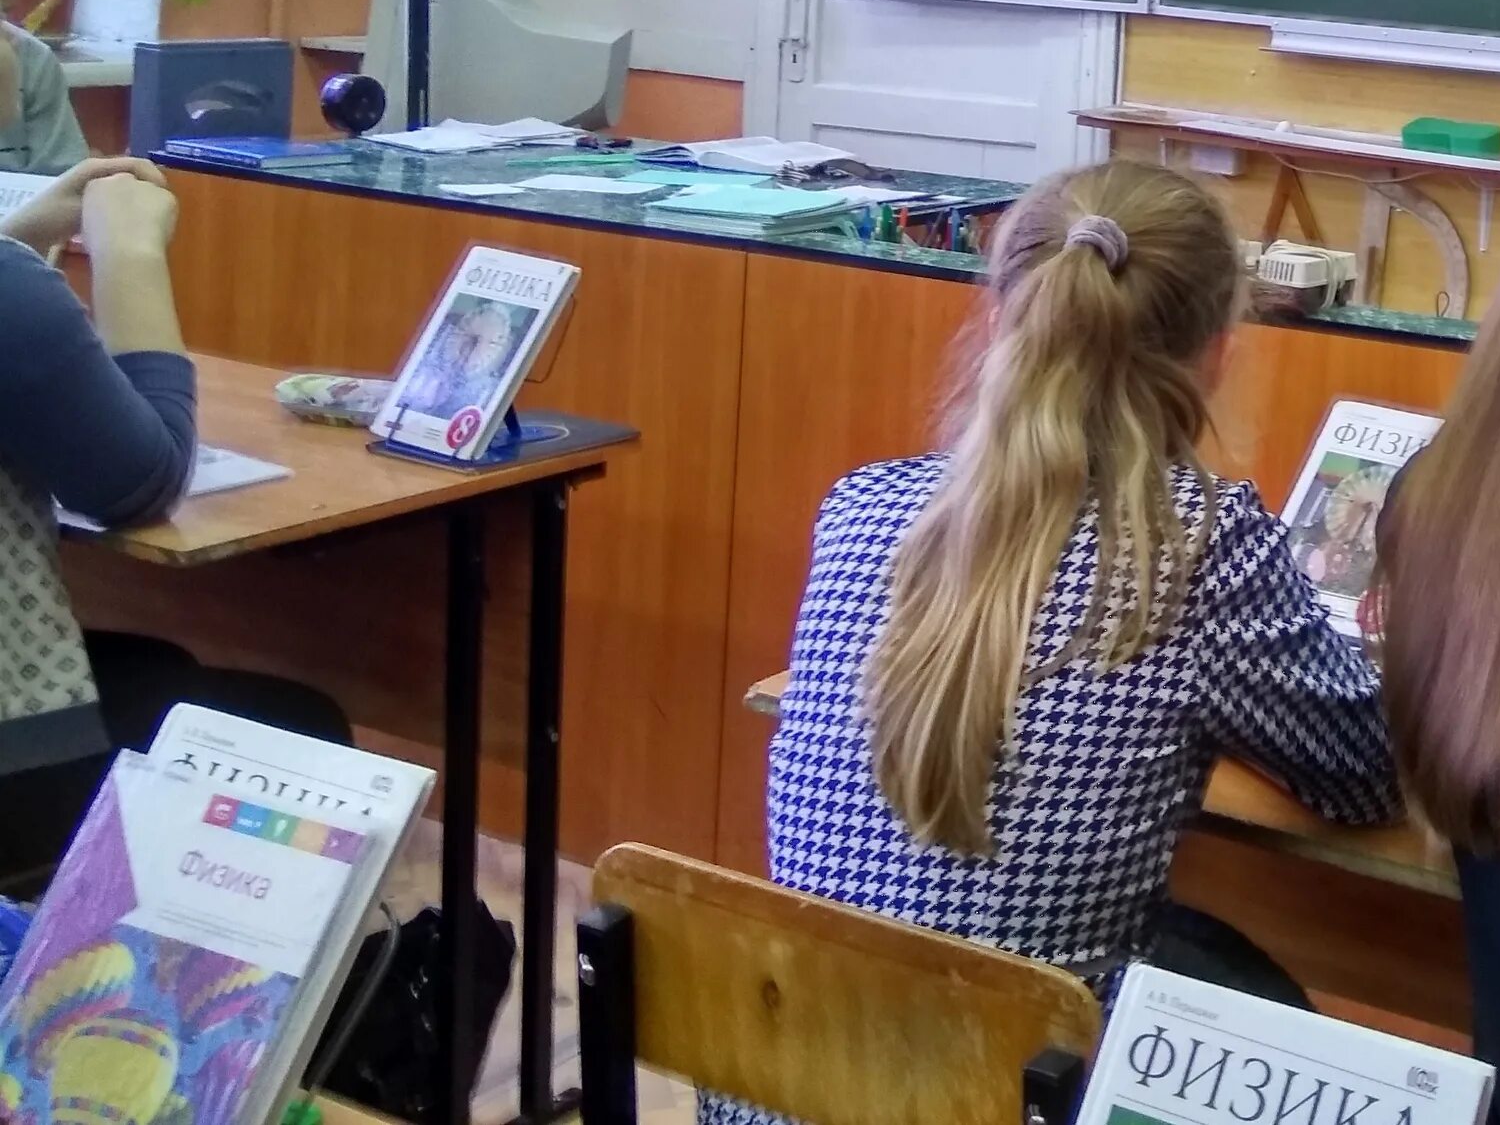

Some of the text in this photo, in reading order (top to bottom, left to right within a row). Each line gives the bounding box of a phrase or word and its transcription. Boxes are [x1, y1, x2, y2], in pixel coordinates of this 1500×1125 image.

[465, 265, 553, 302] ФИЗИКА
[450, 414, 475, 443] 8
[178, 849, 273, 899] Физика
